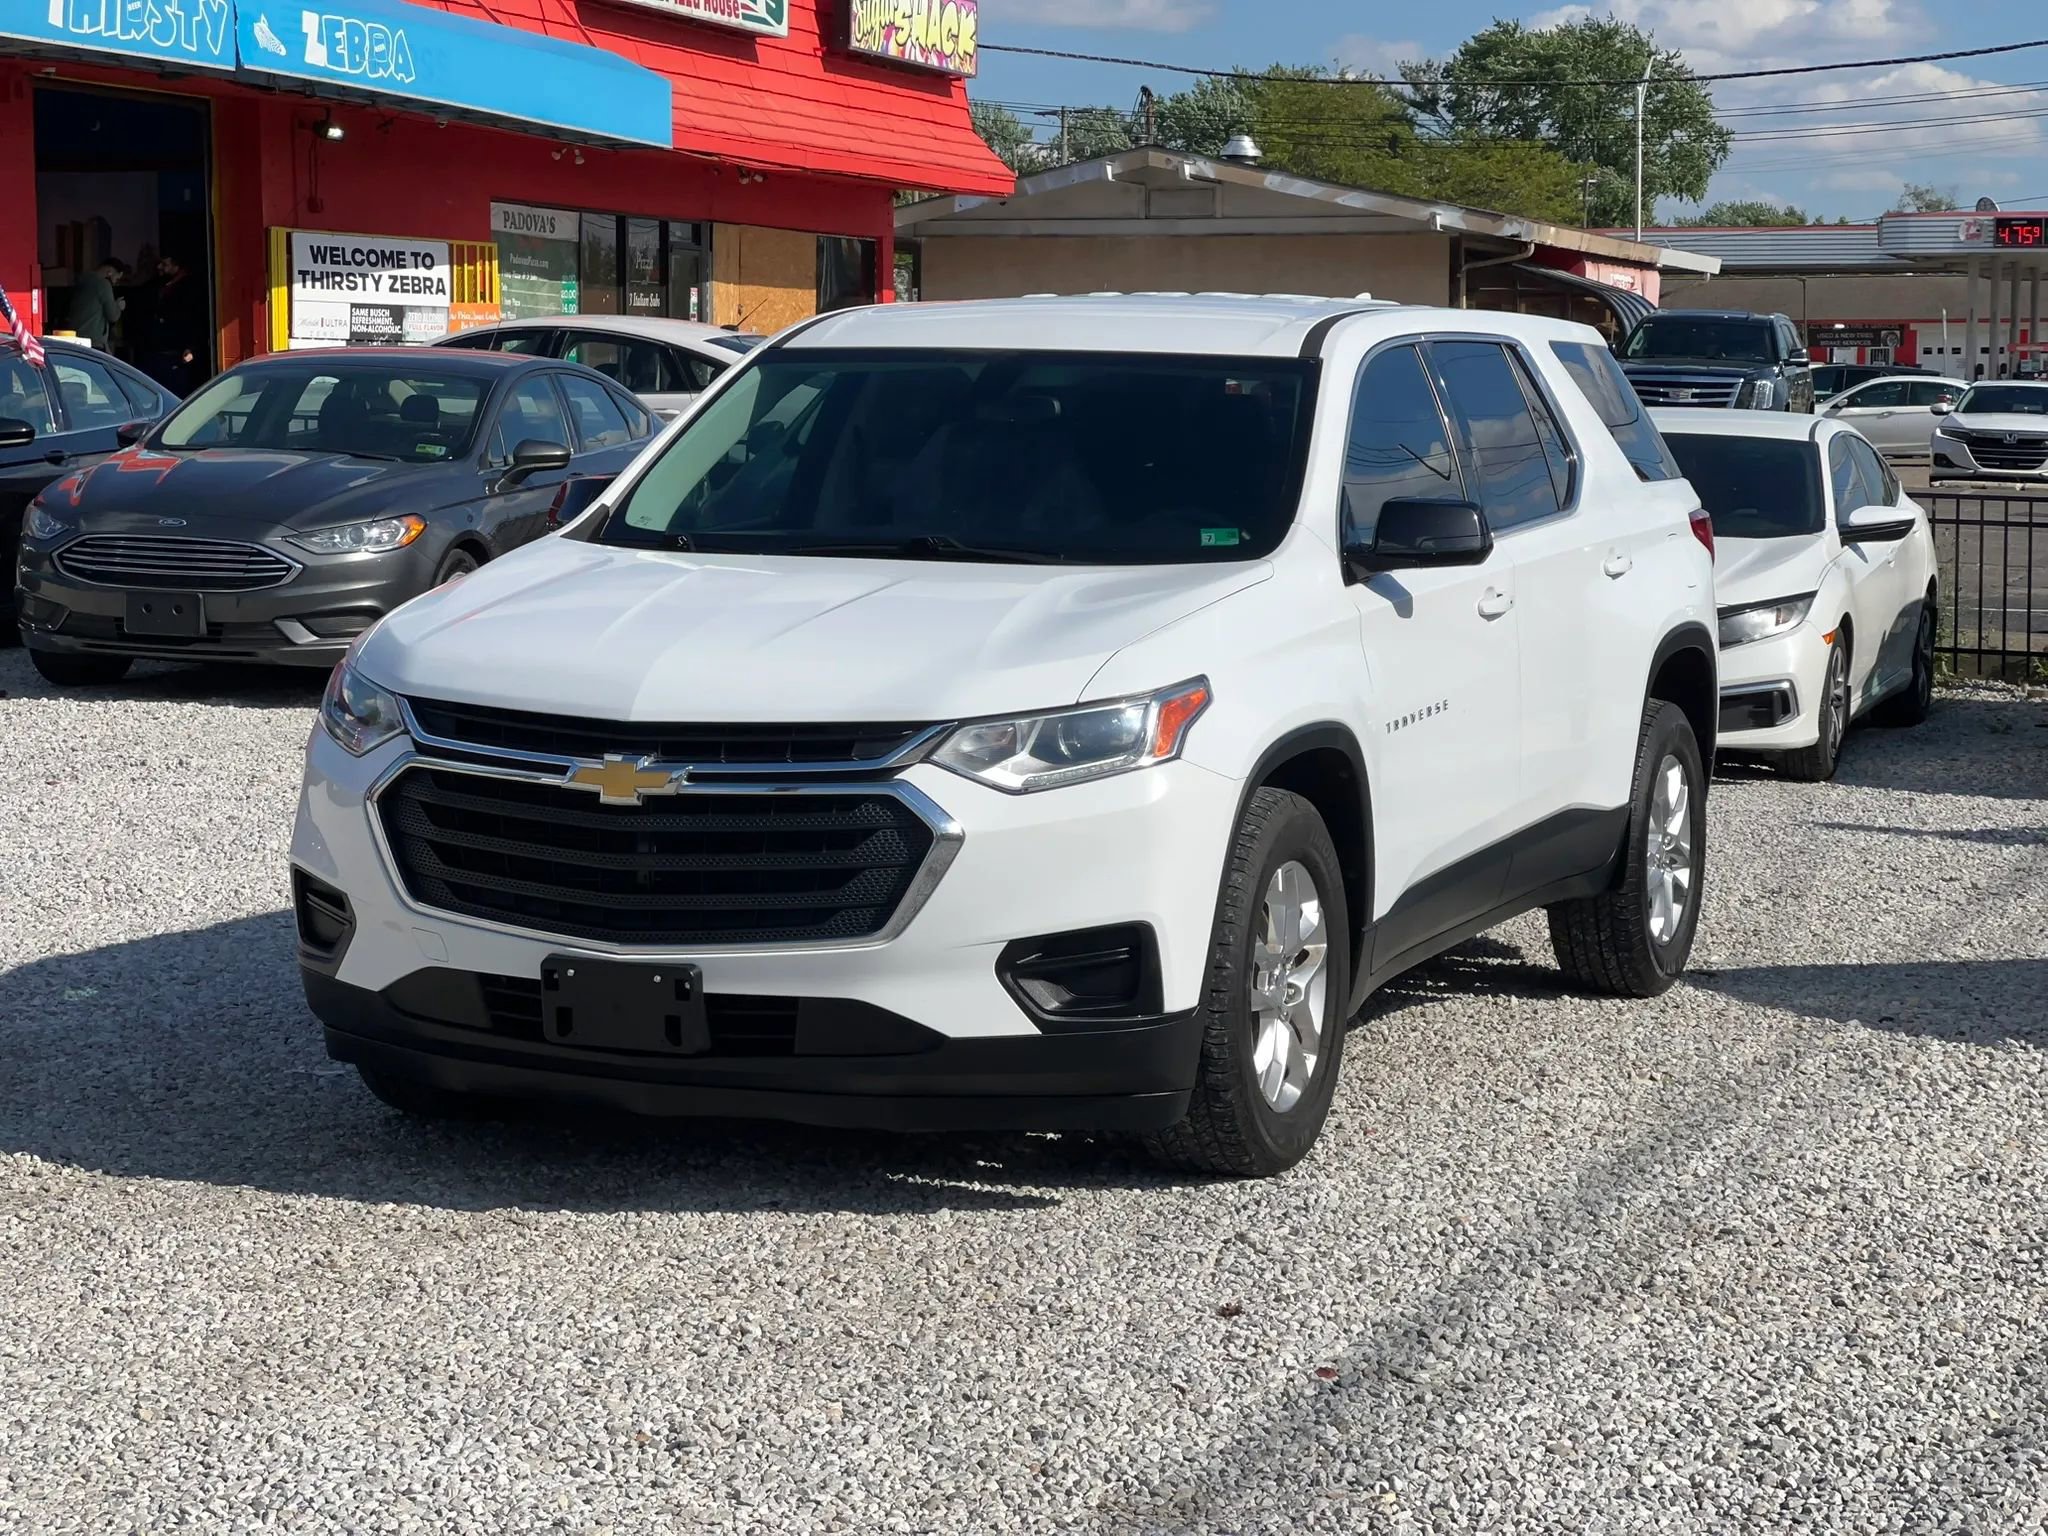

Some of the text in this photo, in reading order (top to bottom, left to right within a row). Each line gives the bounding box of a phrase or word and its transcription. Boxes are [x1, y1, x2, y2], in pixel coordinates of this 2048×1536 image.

[893, 0, 976, 60] SHACK
[302, 10, 416, 83] ZEBRA
[503, 210, 556, 234] PADOVA'S
[309, 245, 435, 270] WELCOME TO
[298, 270, 447, 296] THIRSTY ZEBRA
[325, 319, 348, 328] ULTRA
[352, 307, 390, 317] SAME BUSCH
[352, 316, 394, 326] REFRESHMENT.
[352, 325, 402, 334] NON-ALCOHOLIC.
[1385, 699, 1449, 734] TRAVERSE
